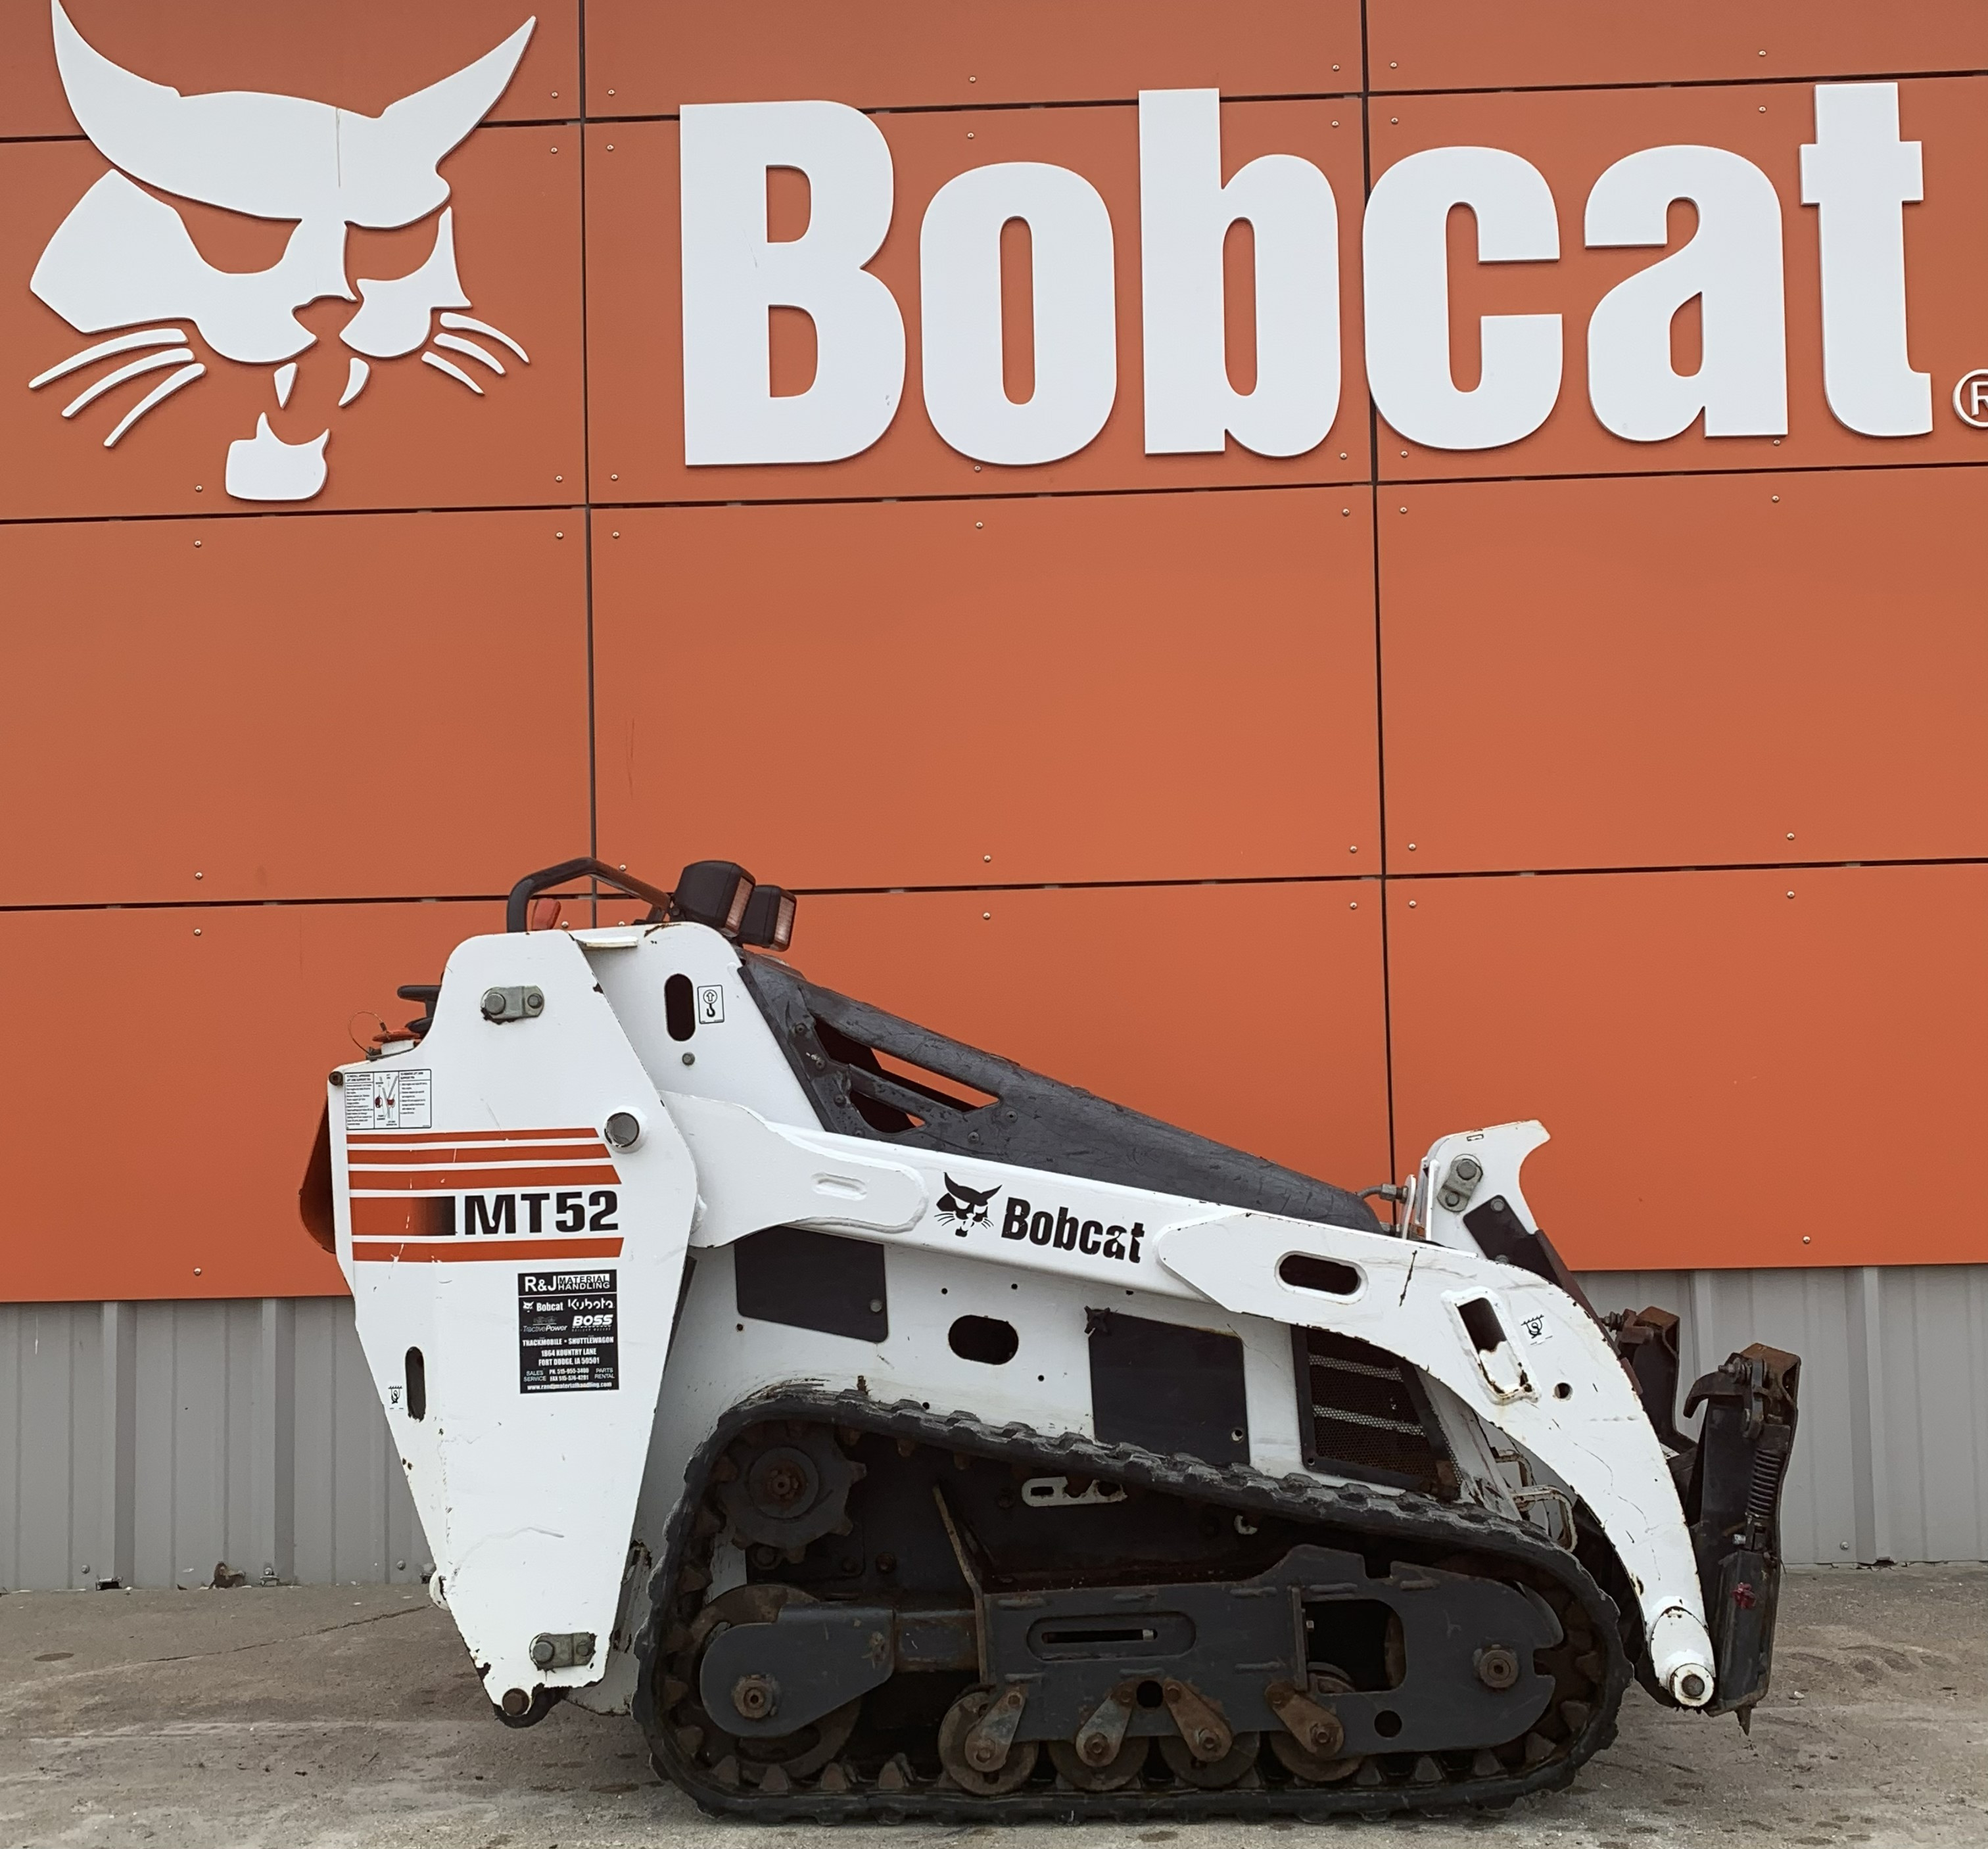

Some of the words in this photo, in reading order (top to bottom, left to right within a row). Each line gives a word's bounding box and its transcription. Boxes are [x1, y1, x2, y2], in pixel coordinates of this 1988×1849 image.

[680, 82, 1933, 467] Bobcat
[465, 1190, 619, 1235] MT52
[1001, 1197, 1145, 1264] Bobcat
[525, 1275, 557, 1292] R&J
[559, 1274, 609, 1283] MATERIAL
[536, 1301, 563, 1312] Bobcat
[568, 1298, 613, 1310] Kubota
[573, 1315, 613, 1326] BOSS
[522, 1338, 562, 1347] TRACKMOBILE
[568, 1336, 614, 1345] SHUTTLEWAGON
